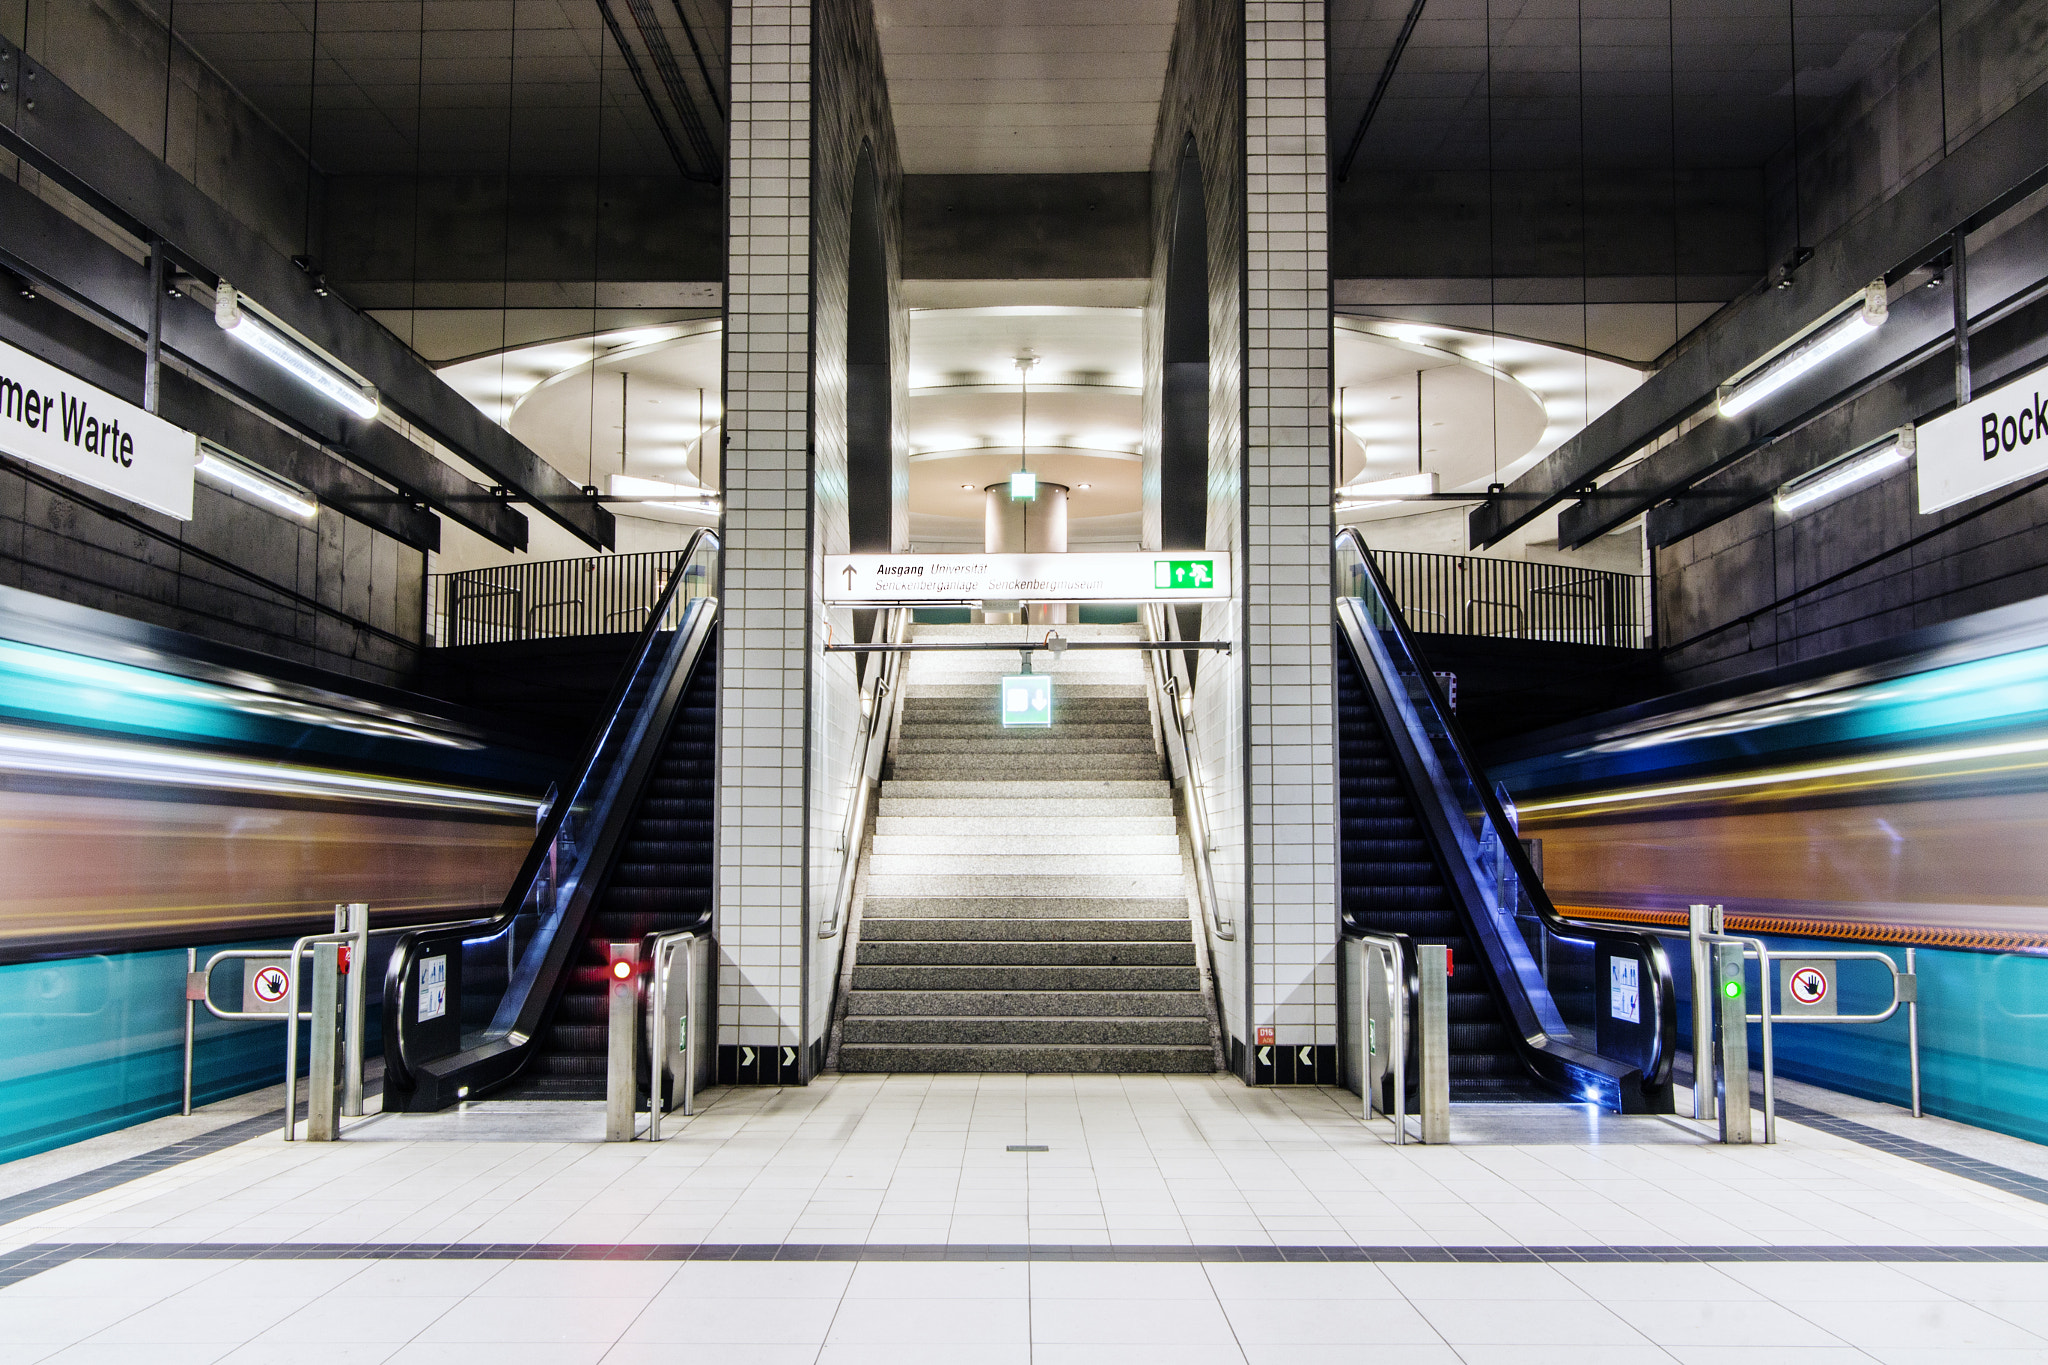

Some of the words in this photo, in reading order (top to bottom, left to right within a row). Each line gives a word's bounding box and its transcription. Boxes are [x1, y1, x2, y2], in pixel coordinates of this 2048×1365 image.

[60, 390, 134, 468] Warte
[1981, 391, 2048, 461] Bock
[875, 580, 979, 592] Senckenberganlage
[988, 579, 1104, 592] Senckenbergmuseum
[876, 564, 924, 577] Ausgang
